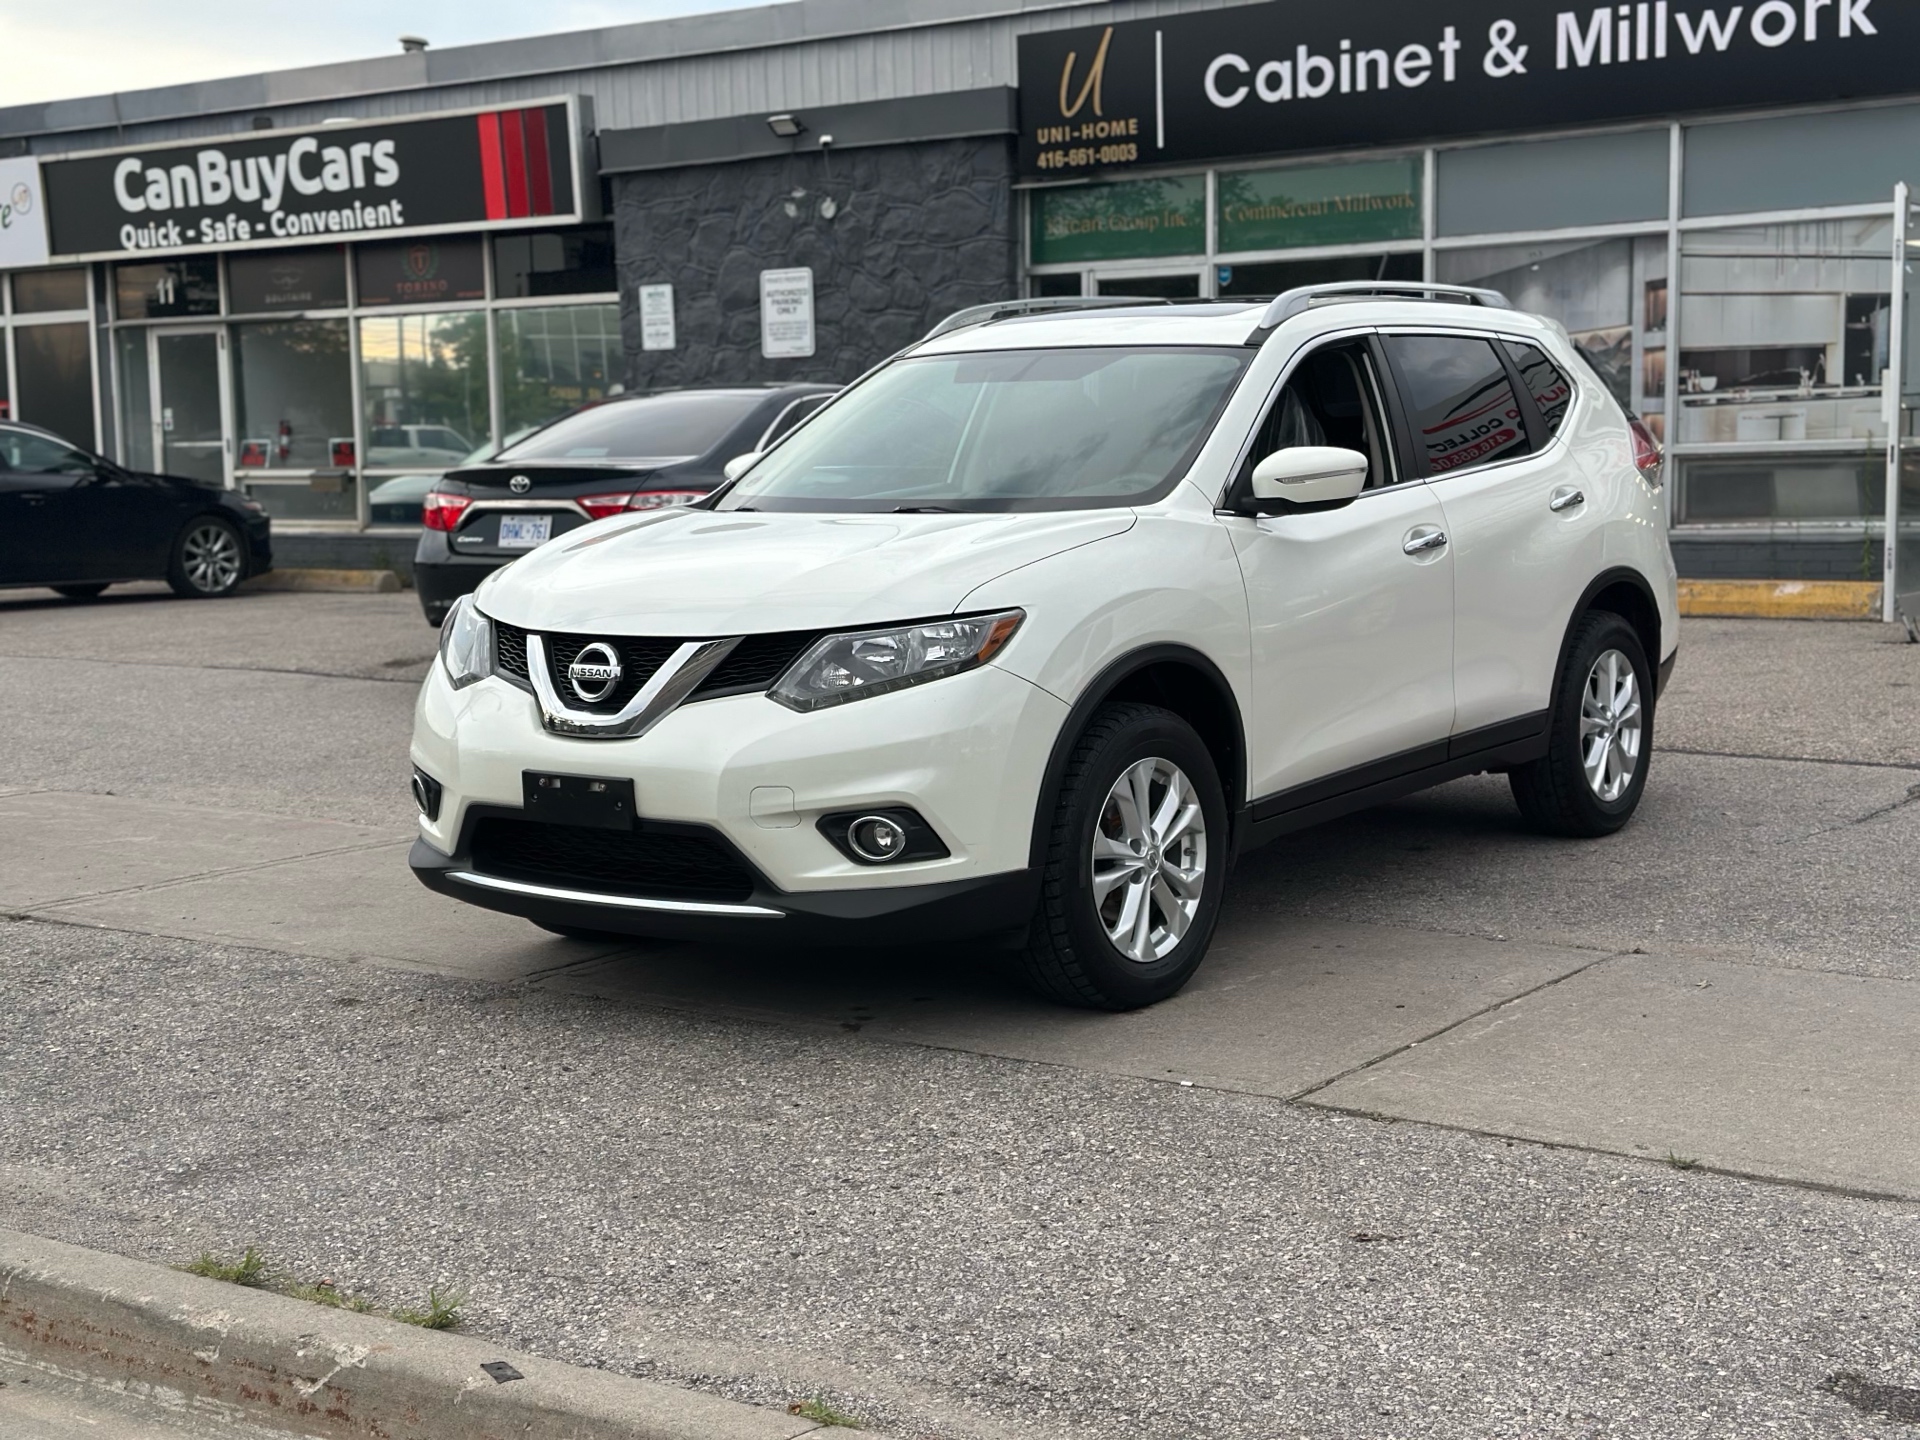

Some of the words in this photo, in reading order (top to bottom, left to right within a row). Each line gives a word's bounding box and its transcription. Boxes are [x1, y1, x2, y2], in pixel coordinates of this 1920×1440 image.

[1204, 26, 1461, 108] Cabinet
[1483, 19, 1528, 77] &
[1556, 0, 1877, 70] Millwork
[1037, 118, 1139, 145] UNI-HOME
[1037, 143, 1138, 170] 416-661-0003
[114, 137, 399, 213] CanBuyCars
[1224, 196, 1328, 222] Commercial
[1334, 190, 1414, 213] Millwork
[120, 219, 182, 250] Quick
[200, 213, 251, 244] Safe
[270, 199, 404, 238] Convenient
[156, 277, 174, 305] 11
[571, 666, 612, 678] NISSAN
